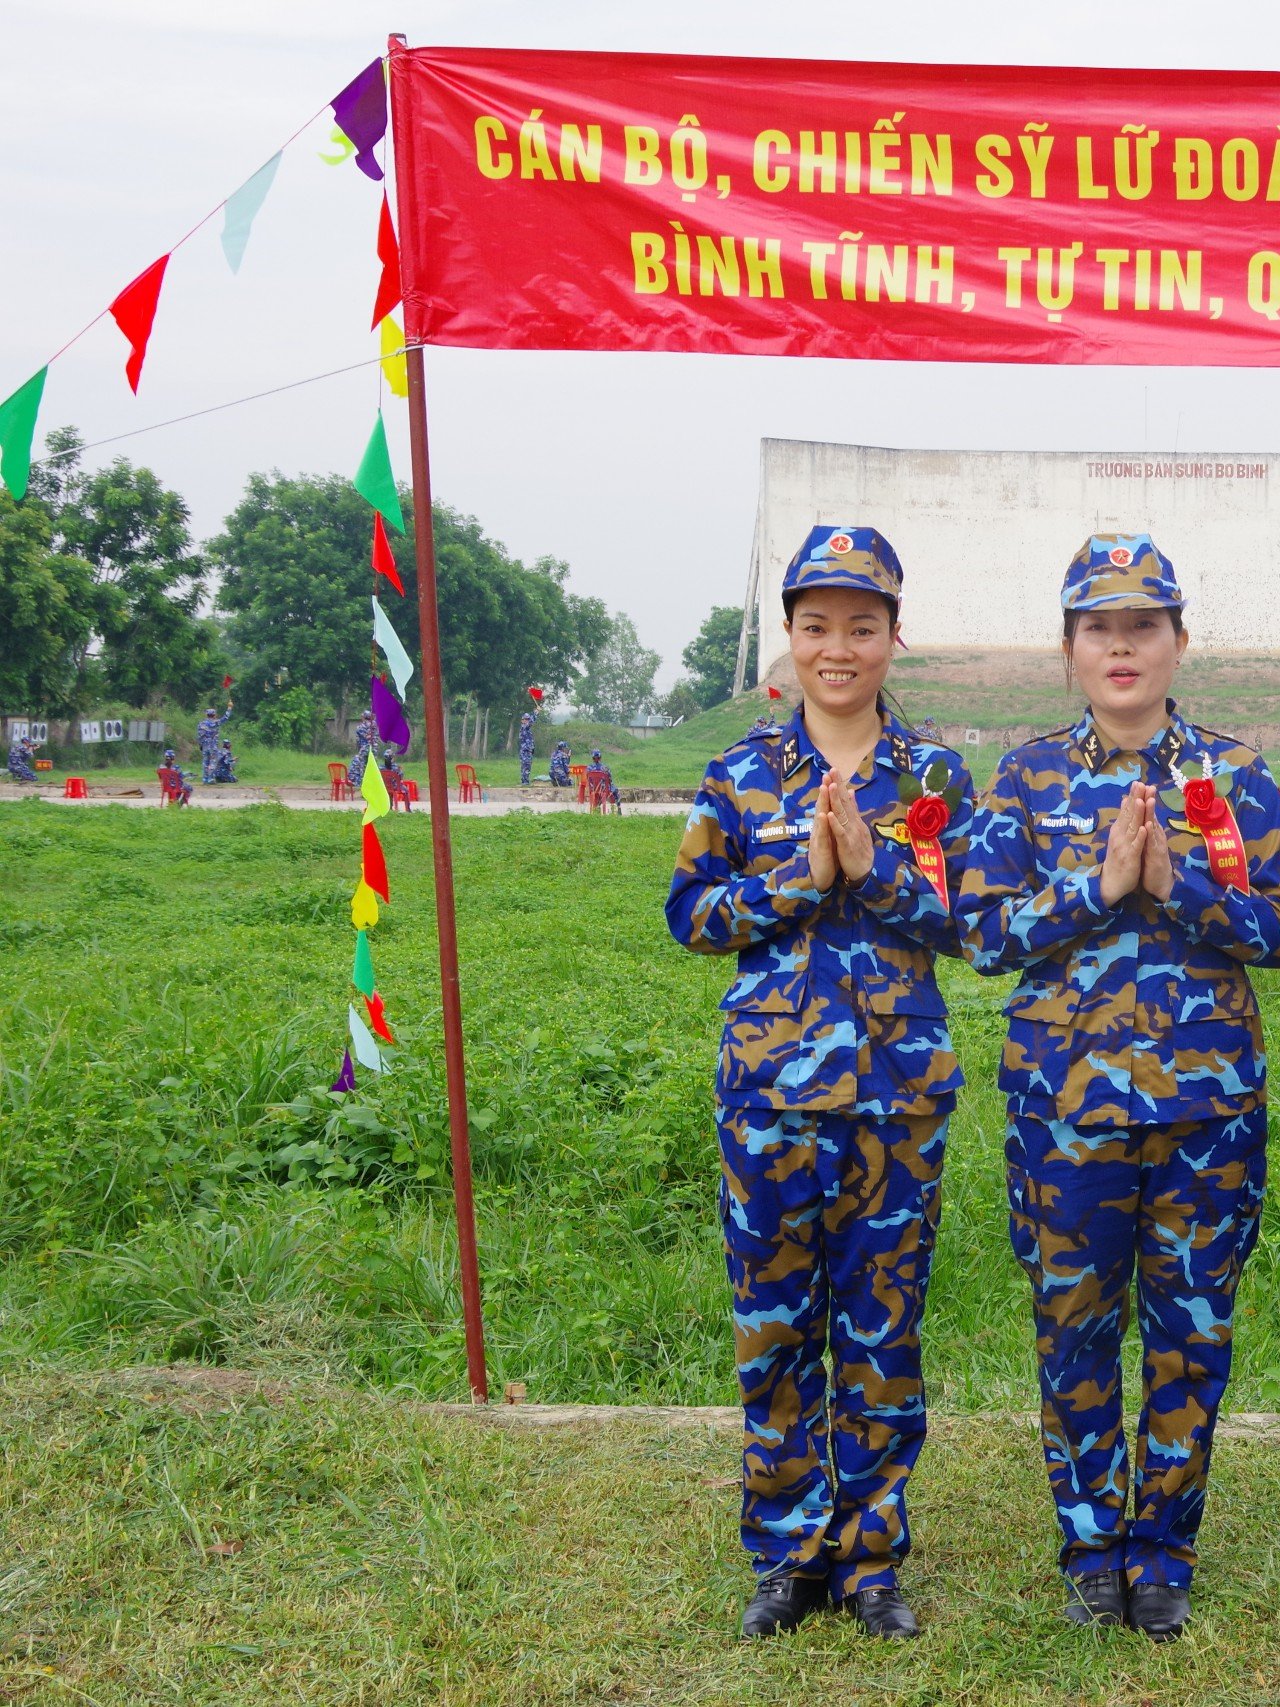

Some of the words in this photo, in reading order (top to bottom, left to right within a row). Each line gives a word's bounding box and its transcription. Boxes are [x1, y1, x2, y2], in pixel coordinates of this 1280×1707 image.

[475, 109, 602, 182] CÁN
[624, 114, 731, 202] BỘ,
[754, 112, 952, 200] CHIẾN
[976, 122, 1054, 199] SỸ
[1077, 123, 1159, 200] LỮ
[631, 221, 784, 299] BÌNH
[803, 230, 976, 313] TĨNH,
[998, 242, 1083, 323] TỰ
[1096, 248, 1223, 320] TIN,
